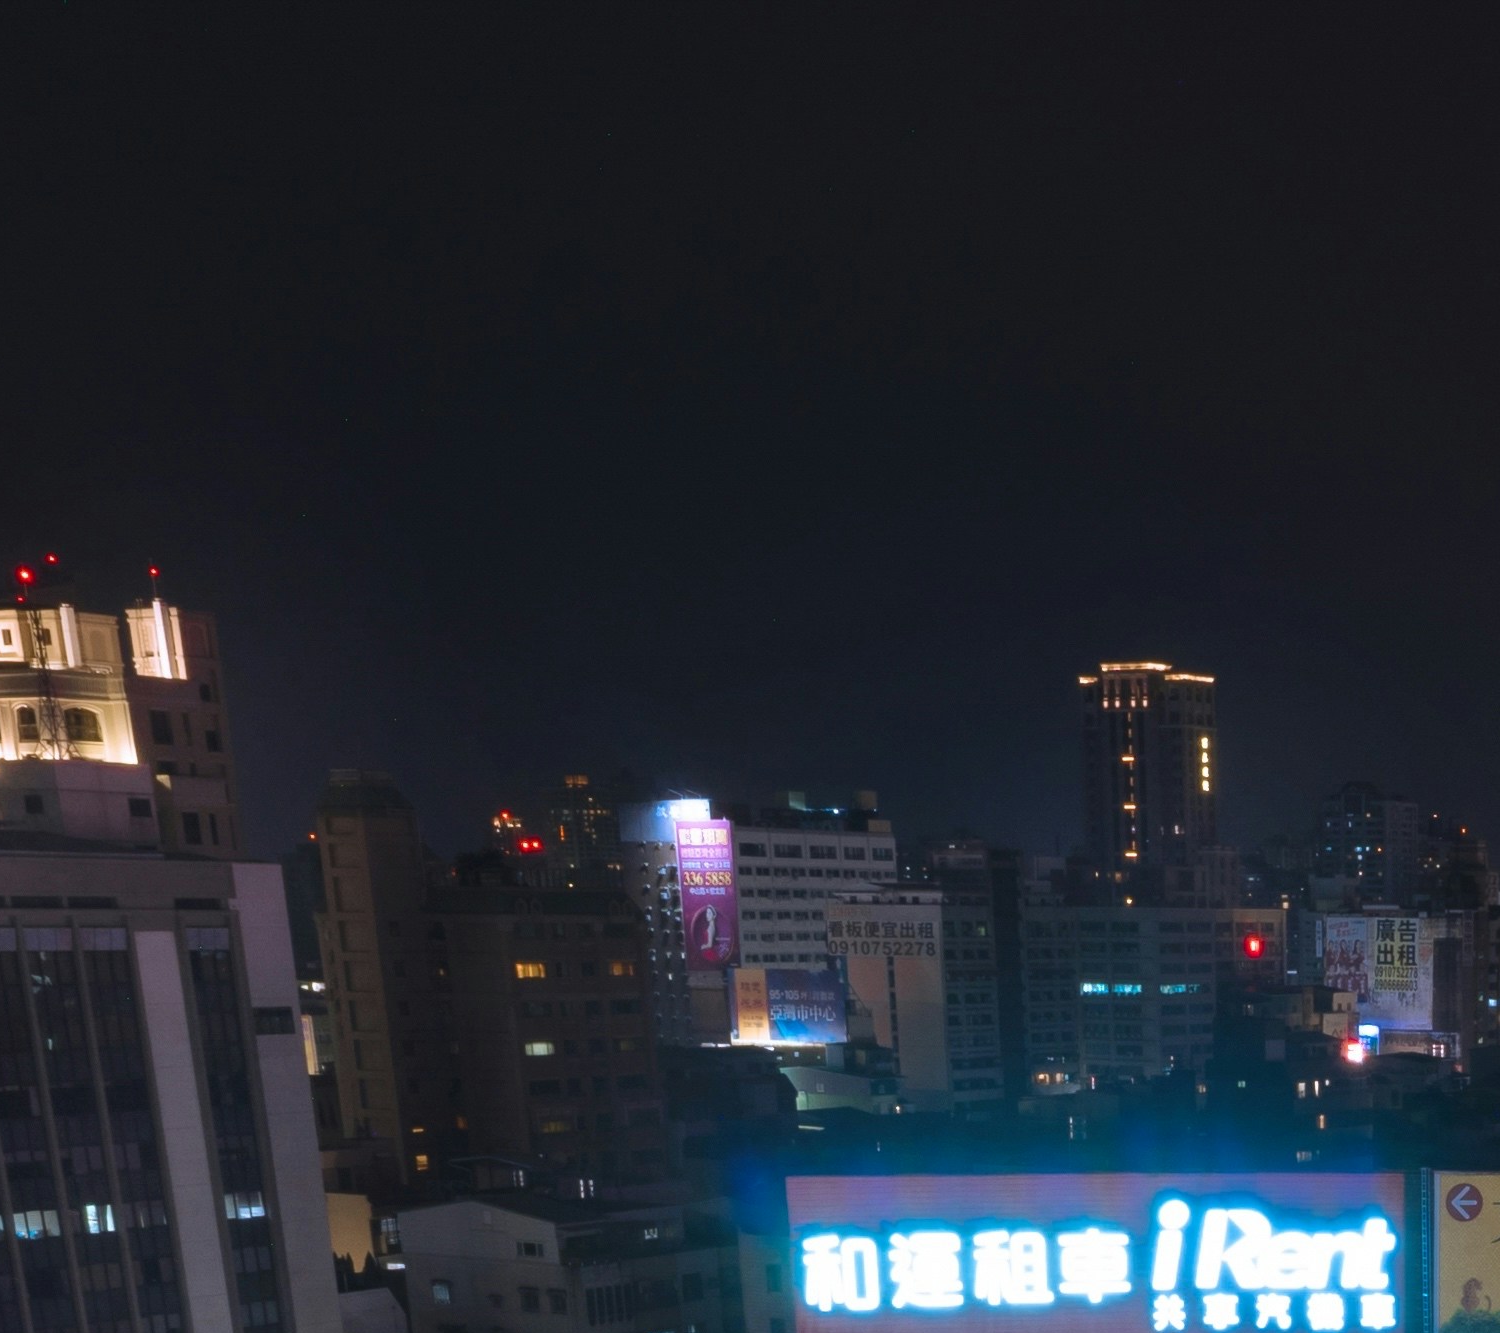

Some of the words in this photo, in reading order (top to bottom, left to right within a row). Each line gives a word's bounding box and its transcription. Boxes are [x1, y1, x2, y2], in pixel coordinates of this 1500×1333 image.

[828, 921, 935, 939] 看板便宜出租
[1376, 918, 1418, 943] 廣告
[828, 940, 936, 957] 0910752278
[1376, 943, 1418, 966] 出租
[802, 1227, 1132, 1313] 和運租車
